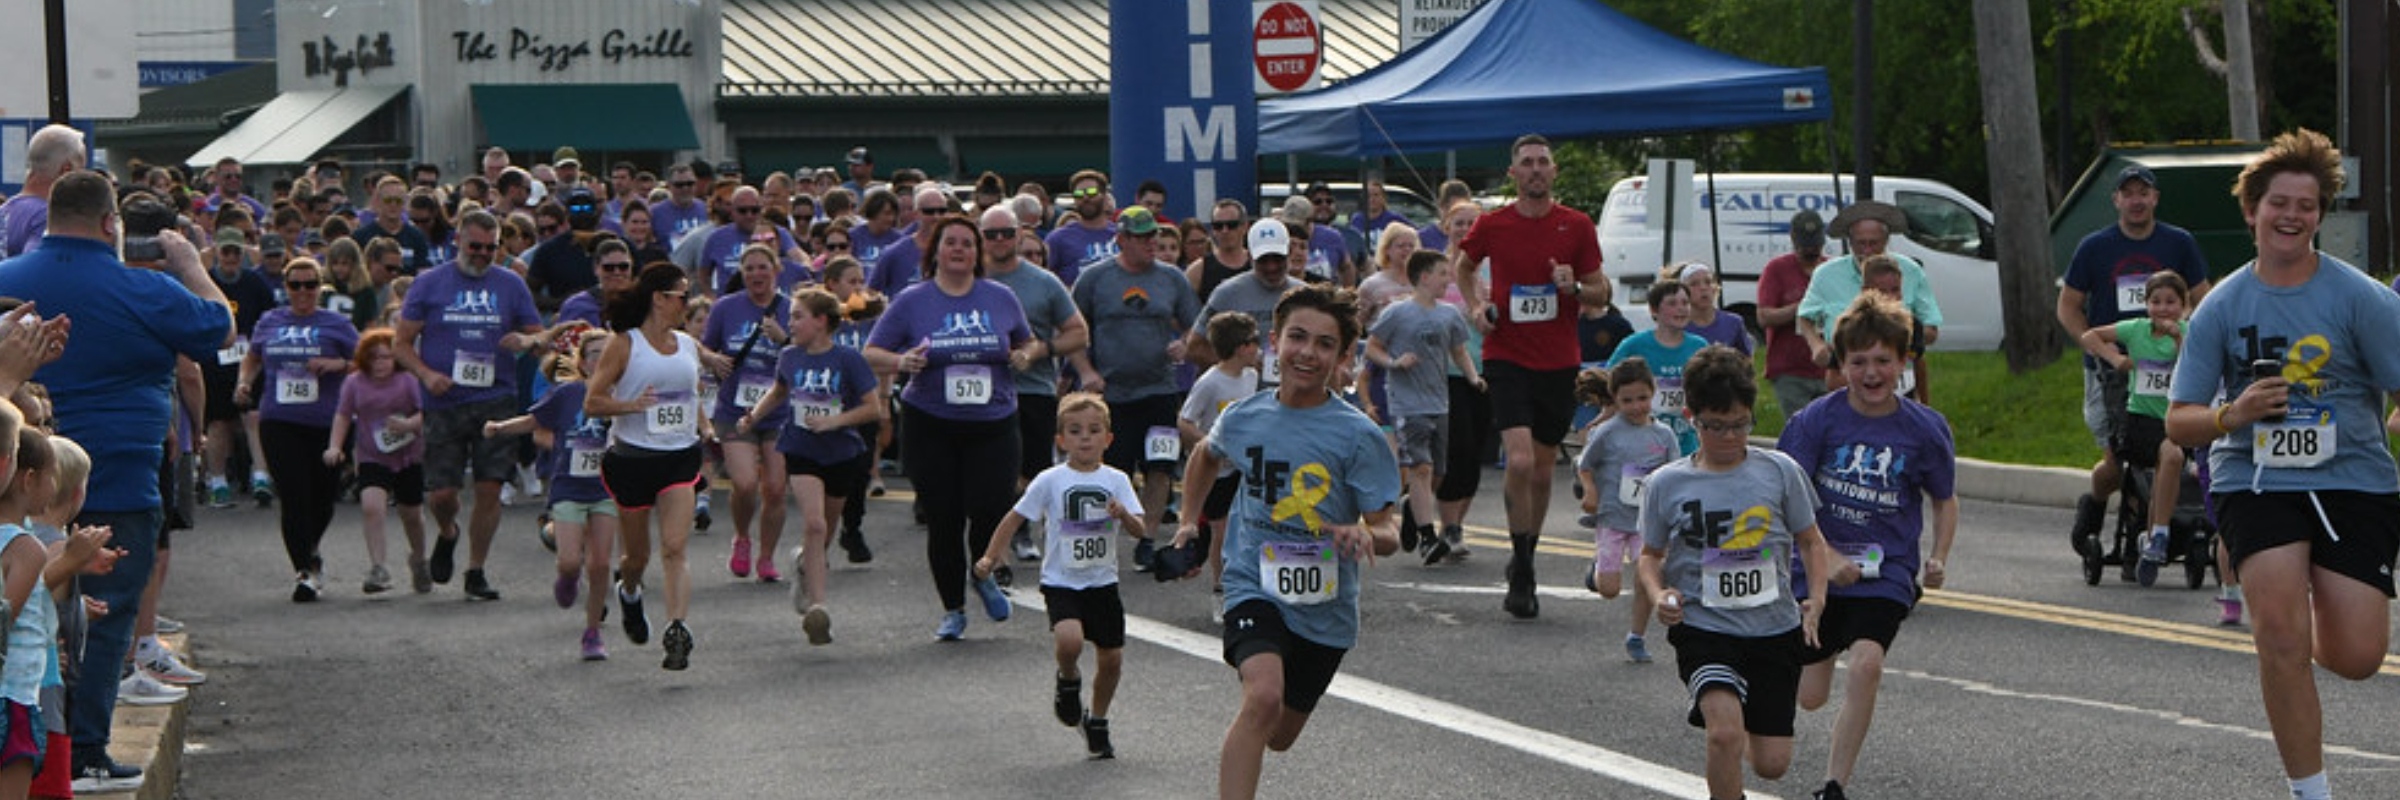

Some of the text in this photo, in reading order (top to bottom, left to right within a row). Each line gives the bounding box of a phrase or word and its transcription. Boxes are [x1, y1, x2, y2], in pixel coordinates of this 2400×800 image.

[1260, 18, 1308, 34] DO NOT
[453, 28, 694, 72] The Pizza Grille
[1267, 60, 1305, 75] ENTER
[1701, 193, 1850, 211] FALCON
[2128, 287, 2147, 304] 76
[1520, 298, 1547, 314] 473
[956, 379, 984, 398] 570
[657, 405, 684, 425] 659
[2272, 428, 2318, 456] 208
[582, 452, 605, 470] 79
[1073, 536, 1106, 561] 580
[1278, 567, 1322, 595] 600
[1719, 569, 1762, 598] 660
